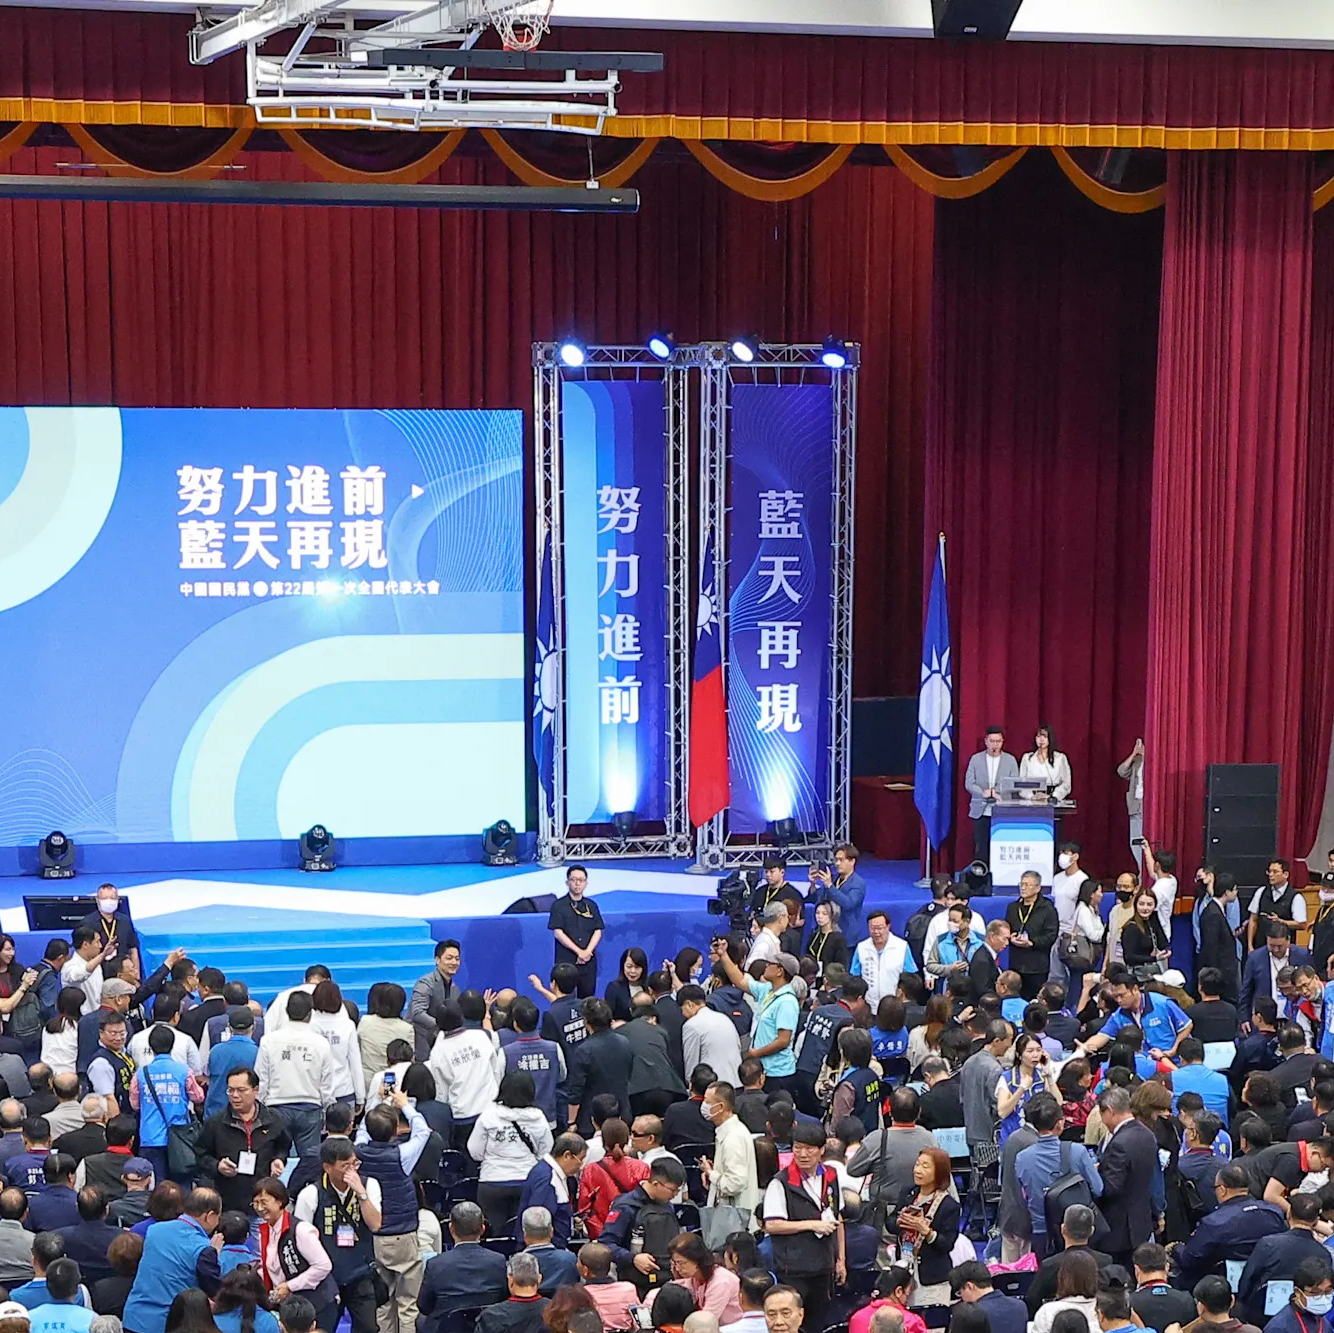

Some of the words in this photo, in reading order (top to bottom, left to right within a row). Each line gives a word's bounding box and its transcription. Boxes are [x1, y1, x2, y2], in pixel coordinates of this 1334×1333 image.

[176, 465, 387, 516] 努力進前
[178, 519, 388, 570] 藍天再現
[179, 581, 251, 597] 中國國民黨
[596, 485, 643, 725] 努力進前
[755, 490, 804, 733] 藍天再現
